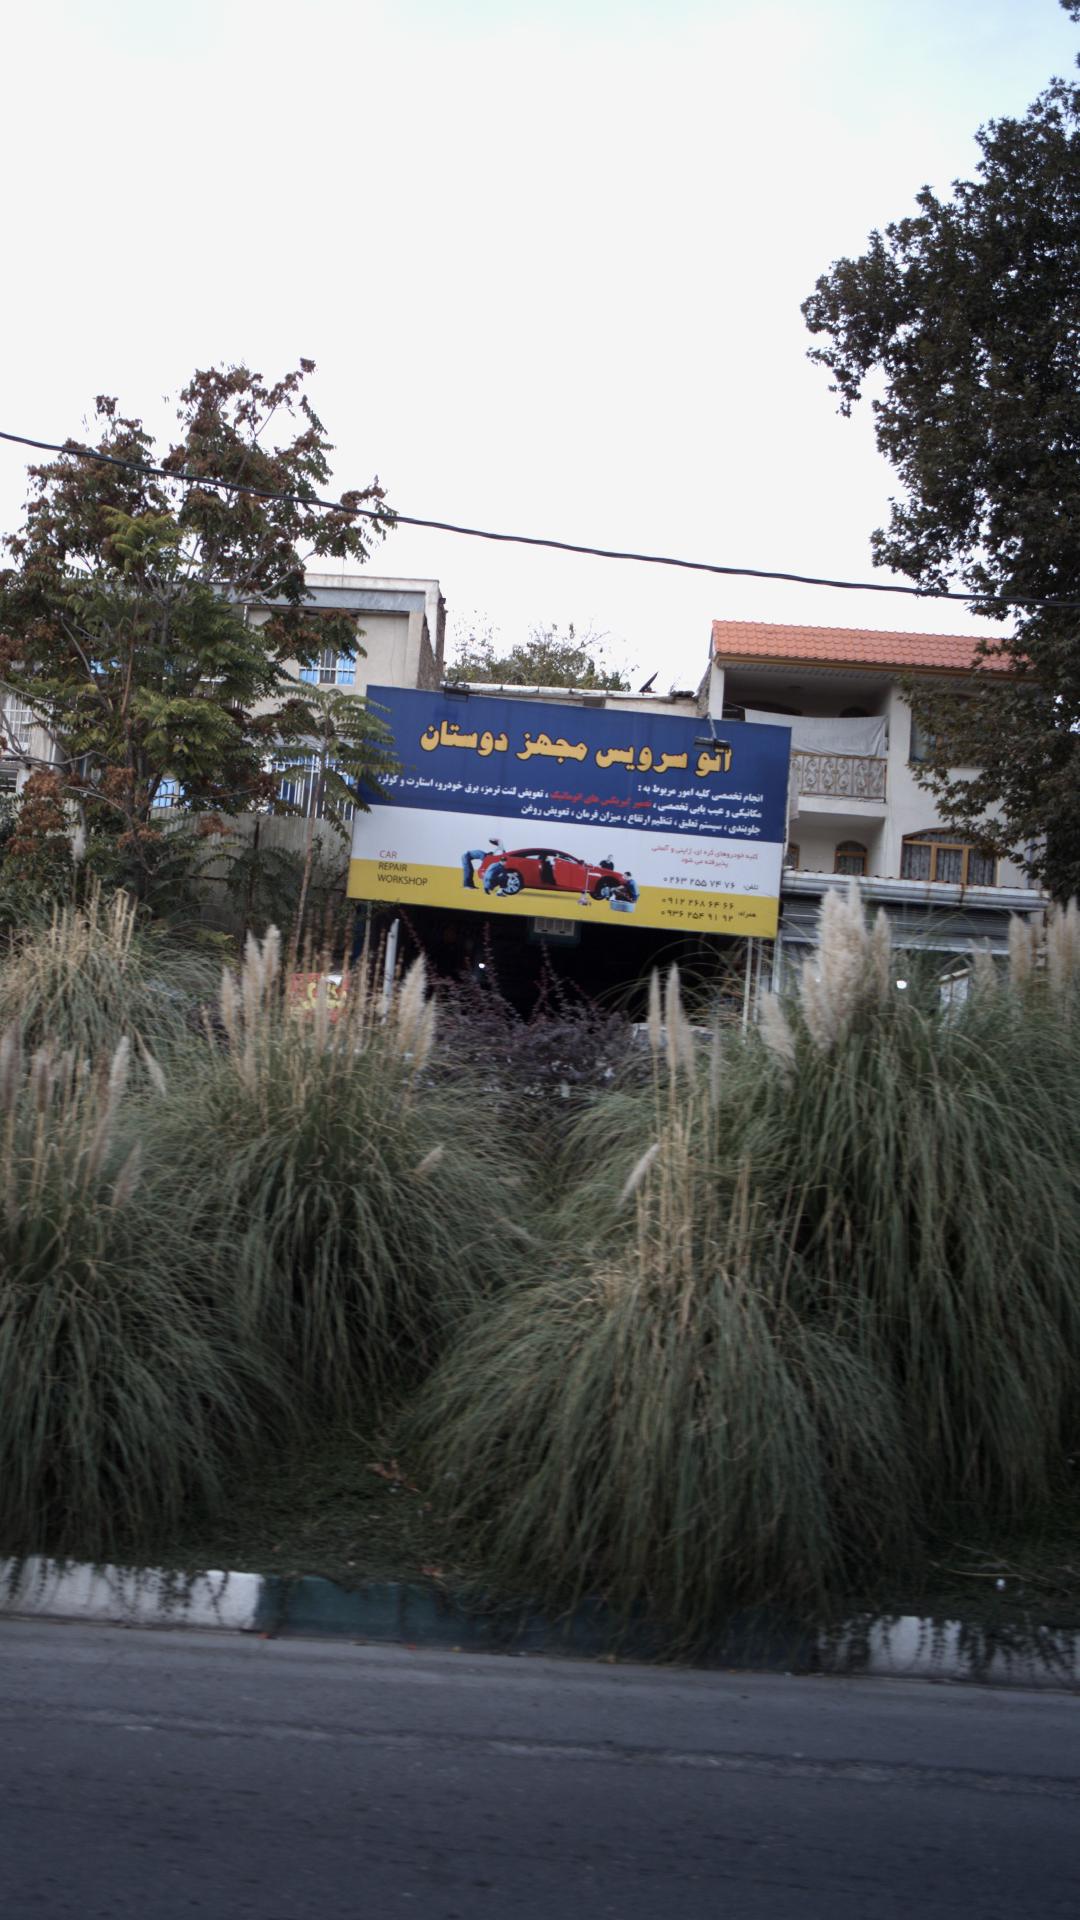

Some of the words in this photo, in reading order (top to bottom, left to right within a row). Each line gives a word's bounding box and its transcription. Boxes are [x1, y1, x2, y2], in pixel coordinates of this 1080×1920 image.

[419, 720, 509, 757] دوستان
[516, 732, 588, 765] مجهز
[595, 746, 688, 773] سرویس
[694, 746, 732, 777] اتو
[400, 779, 405, 787] و
[406, 777, 434, 788] استارت
[464, 784, 479, 794] برق
[501, 786, 517, 795] لنت
[517, 788, 544, 799] تعویض
[652, 784, 676, 797] مربوط
[677, 788, 694, 798] امور
[695, 789, 710, 799] کلیه
[711, 792, 742, 801] تخصصی
[743, 793, 763, 804] انجام
[520, 803, 542, 816] روغن
[543, 806, 570, 818] تعویض
[689, 804, 706, 815] یابی
[707, 808, 724, 816] عیب
[725, 810, 730, 818] و
[731, 808, 762, 819] مکانیکی
[599, 811, 621, 823] میزان
[651, 816, 673, 826] تنظیم
[699, 821, 722, 832] سیستم
[379, 849, 398, 859] CAR
[378, 861, 408, 871] REPAIR
[377, 873, 428, 886] WORKSHOP
